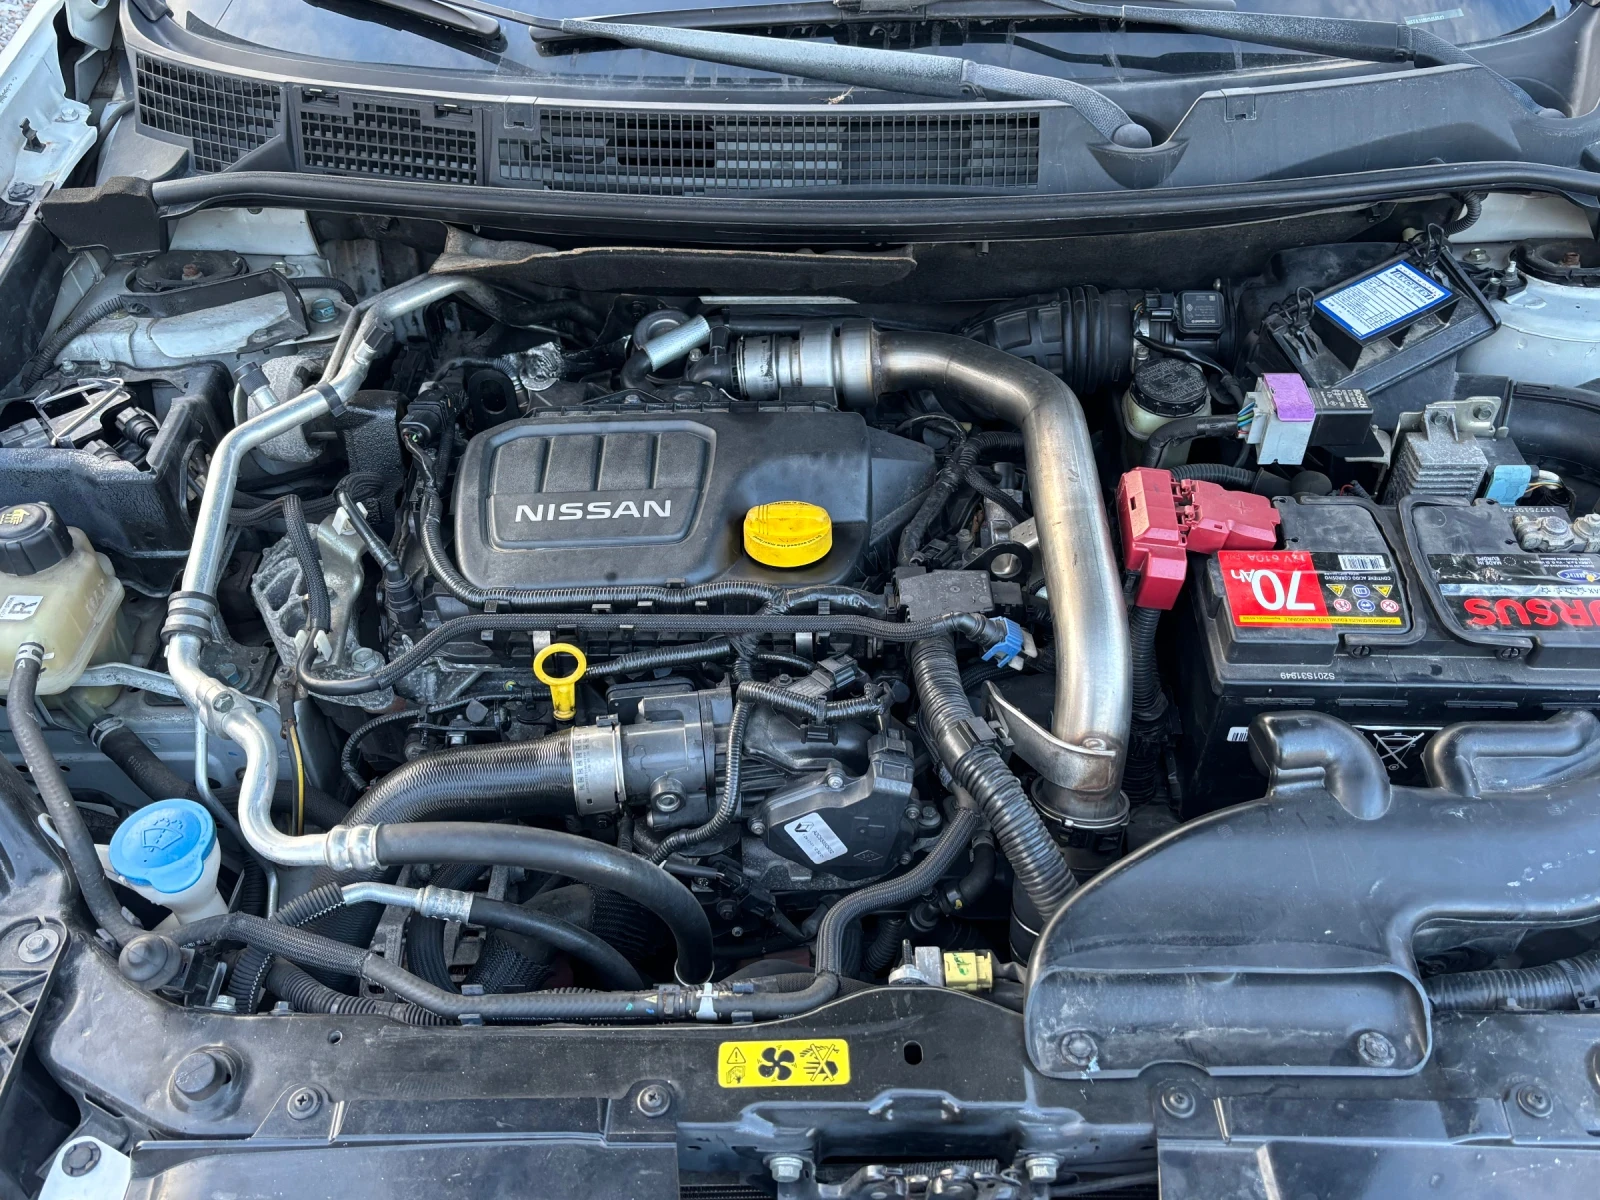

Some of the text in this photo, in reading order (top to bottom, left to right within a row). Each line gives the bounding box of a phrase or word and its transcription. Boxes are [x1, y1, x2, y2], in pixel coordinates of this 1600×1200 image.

[1353, 389, 1368, 408] BOSCH
[515, 500, 671, 522] NISSAN
[8, 602, 38, 614] R
[17, 659, 26, 669] A
